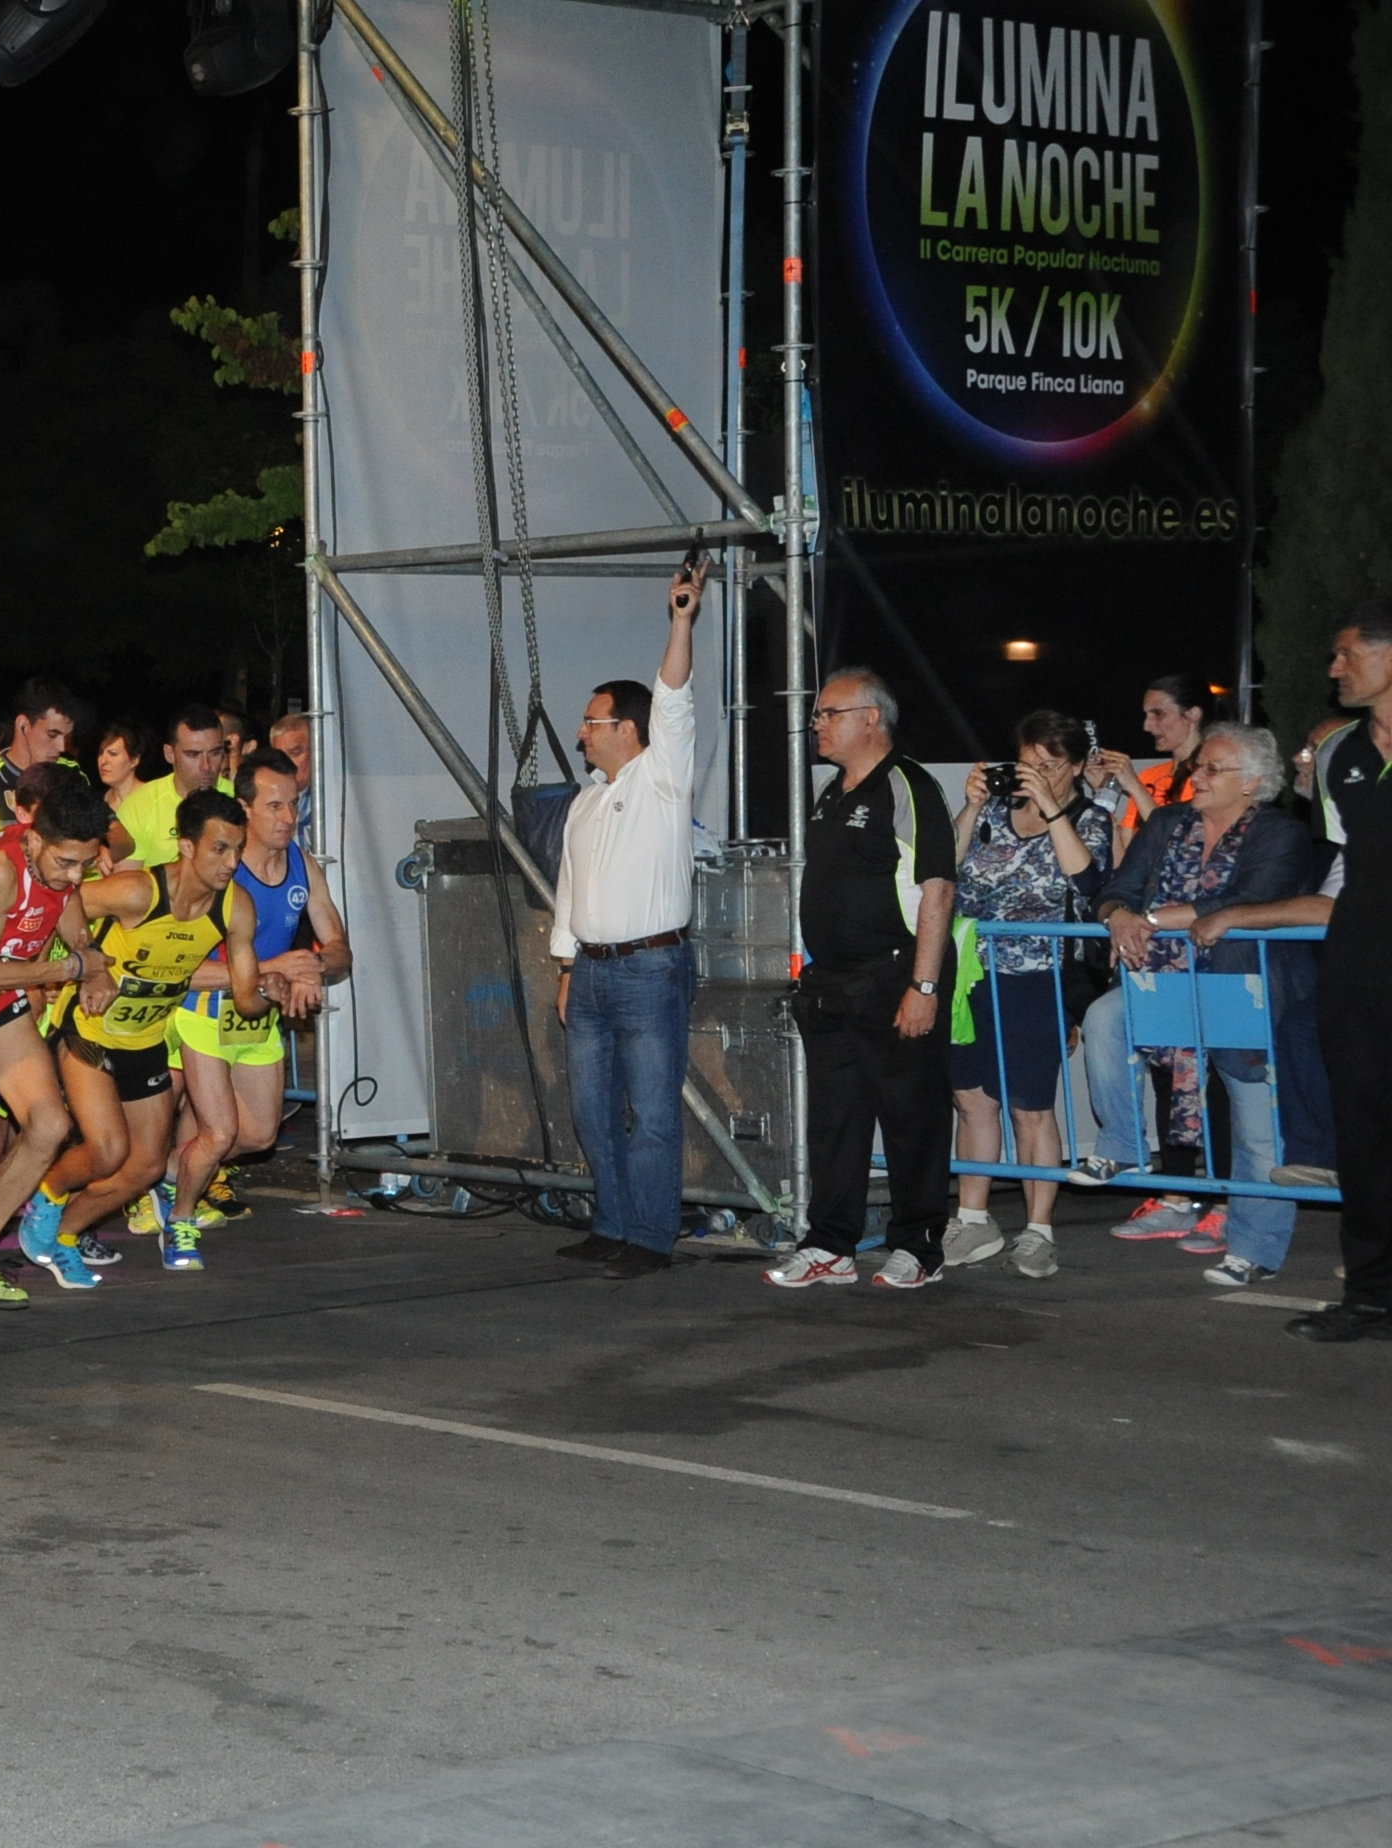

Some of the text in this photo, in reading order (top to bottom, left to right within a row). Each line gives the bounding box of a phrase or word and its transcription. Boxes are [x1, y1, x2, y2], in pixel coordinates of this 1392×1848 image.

[923, 10, 1159, 142] ILUMINA
[919, 132, 1160, 244] LA NOCHE
[919, 238, 1160, 276] II Carrera Popular Nocturna
[965, 285, 1016, 357] 5K
[1058, 290, 1124, 360] 10K
[966, 368, 1124, 396] Parque Finca Liana
[842, 476, 1238, 540] iluminalanoche.es
[291, 891, 305, 904] 42
